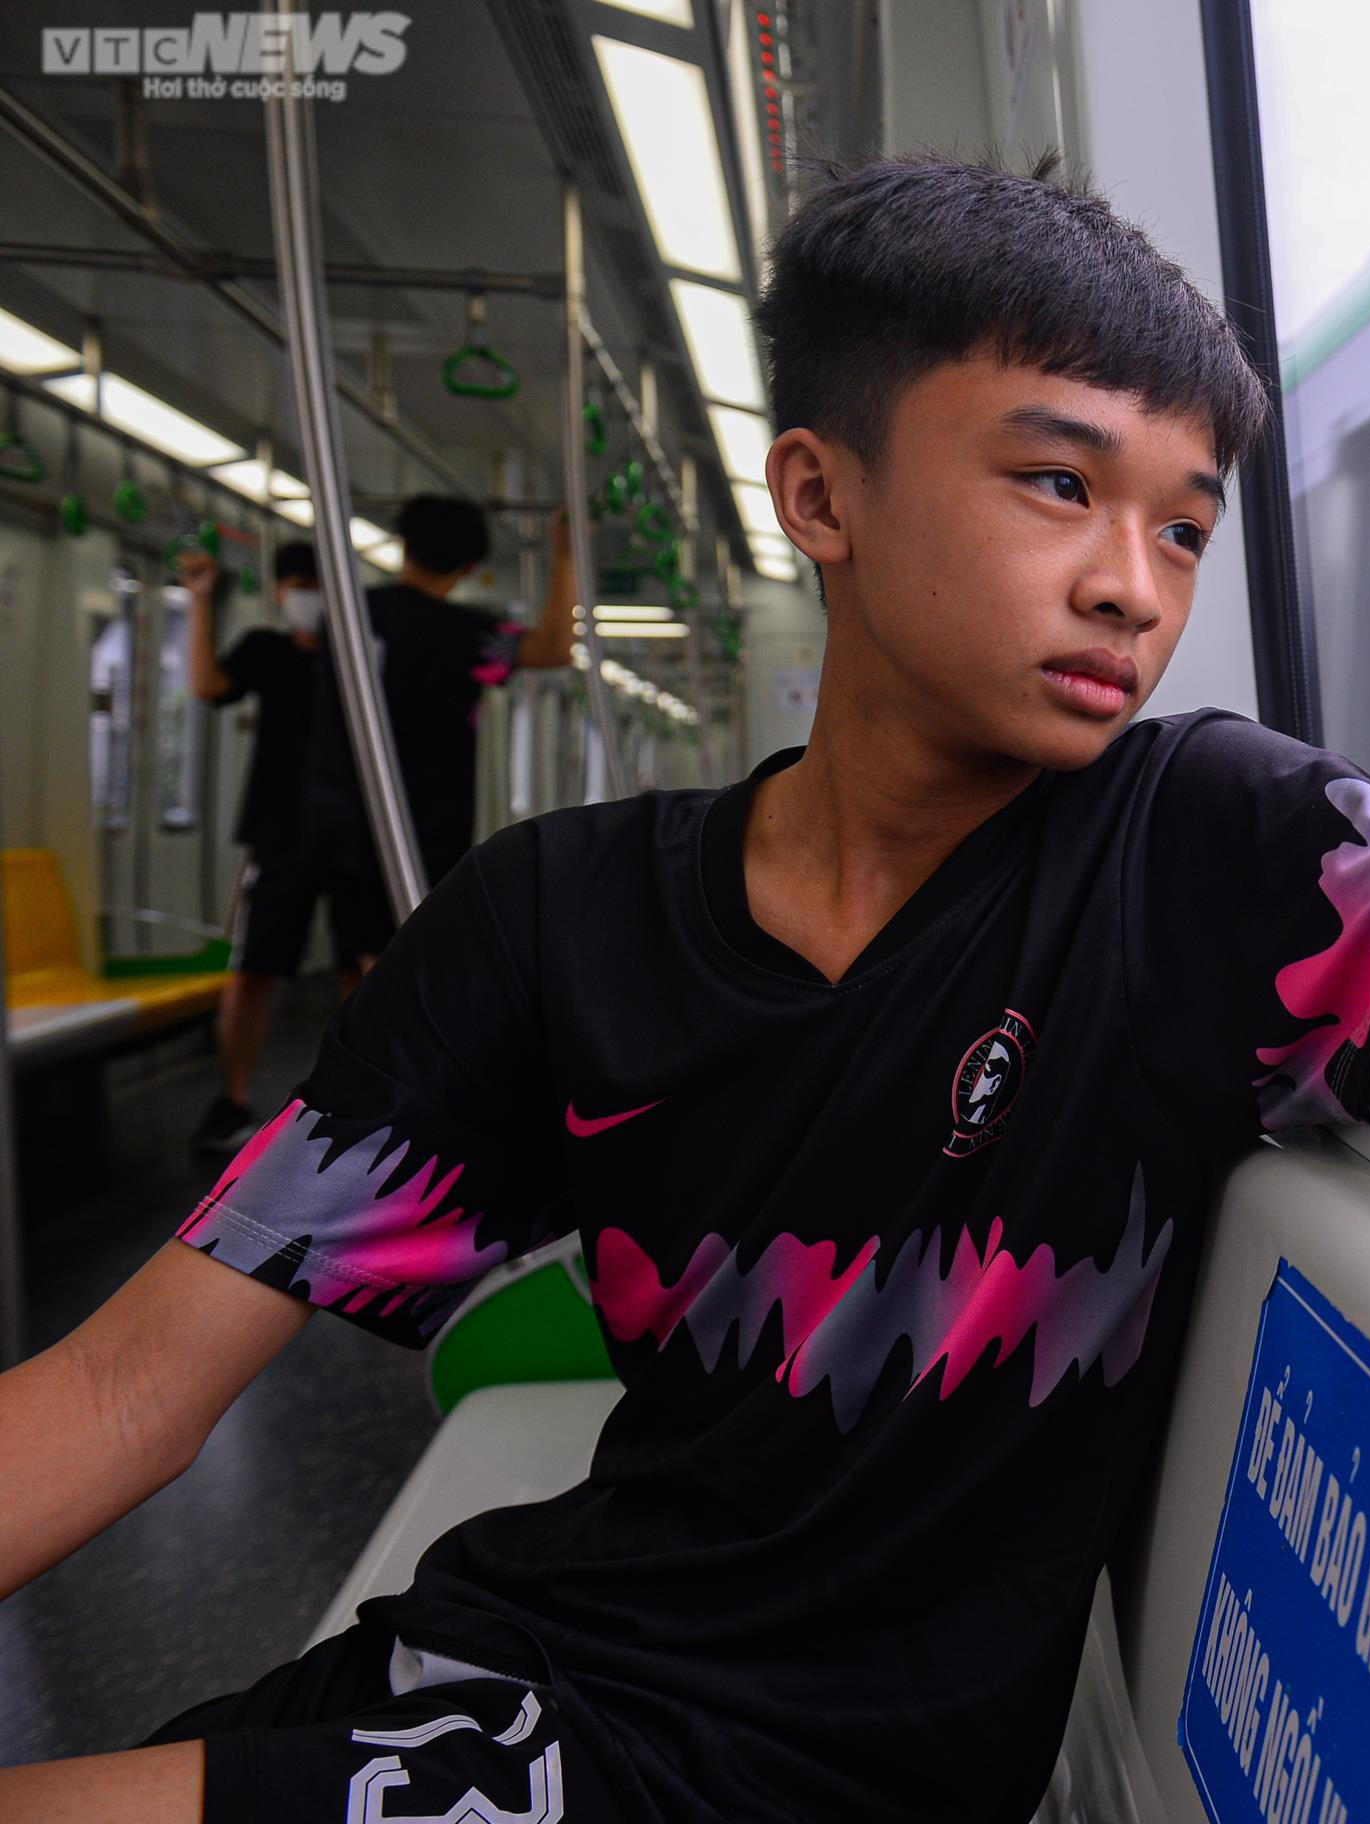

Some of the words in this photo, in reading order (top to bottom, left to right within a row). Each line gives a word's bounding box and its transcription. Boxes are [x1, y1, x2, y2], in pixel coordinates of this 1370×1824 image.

[1246, 1364, 1292, 1501] ĐỂ
[1268, 1389, 1325, 1565] ĐẢM
[1309, 1445, 1368, 1628] BẢO
[1201, 1571, 1271, 1778] KHÔNG
